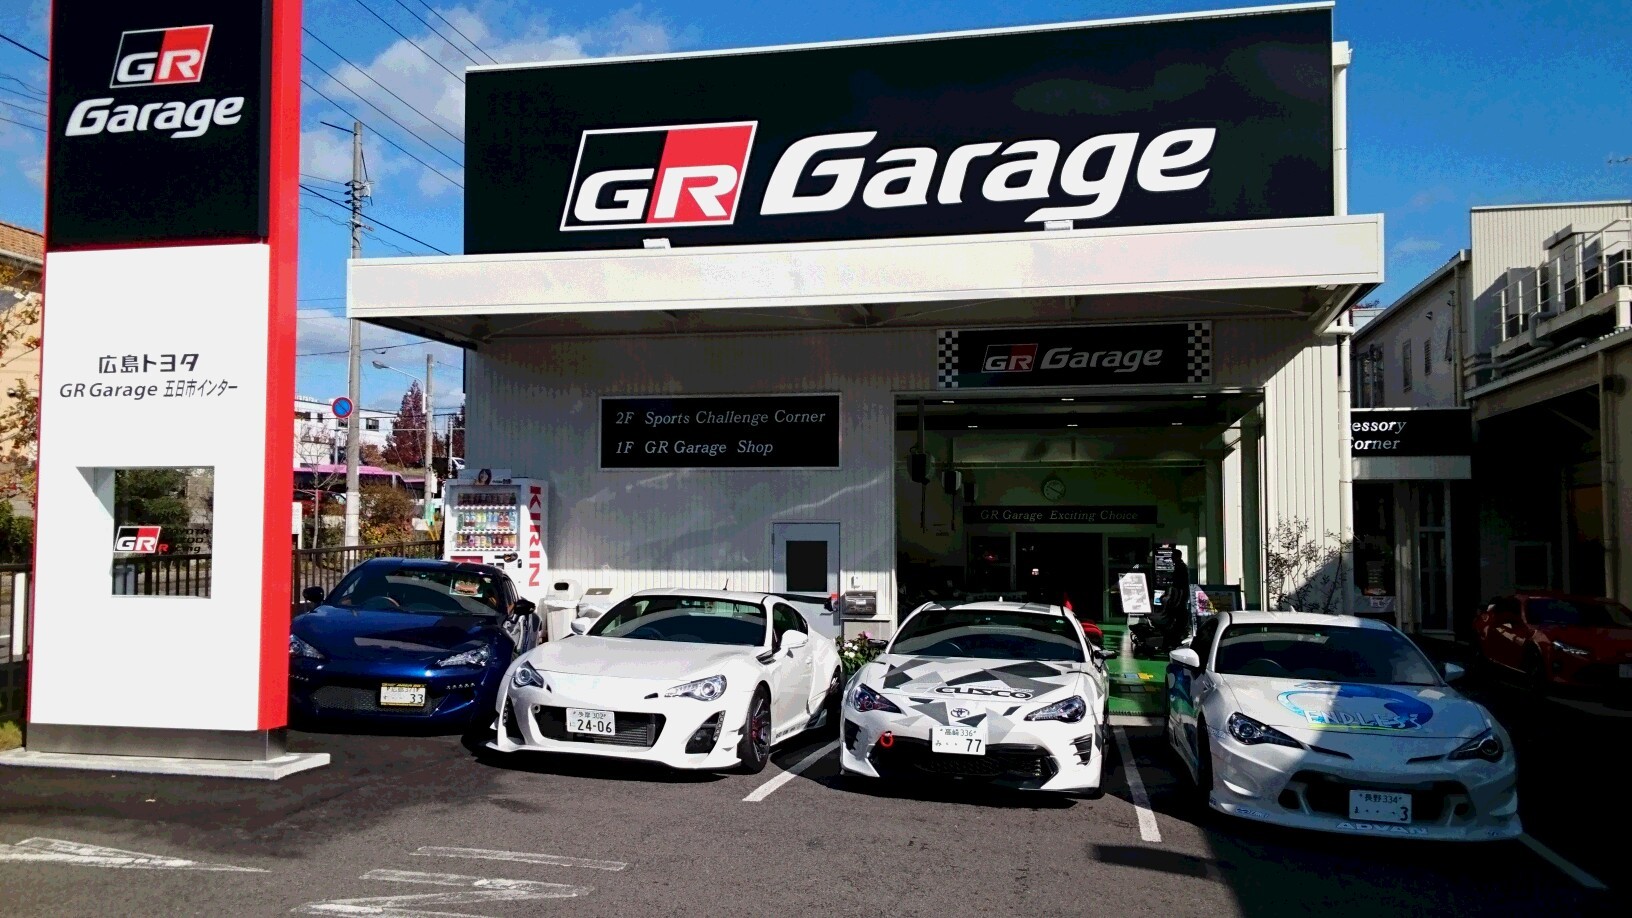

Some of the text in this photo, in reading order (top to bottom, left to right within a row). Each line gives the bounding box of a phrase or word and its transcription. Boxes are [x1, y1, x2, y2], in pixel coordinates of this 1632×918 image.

[117, 49, 201, 82] GR
[65, 97, 245, 138] Garage
[573, 127, 1217, 223] GR Garage
[99, 354, 199, 374] 広島トヨタ
[985, 347, 1164, 373] GR Garage
[59, 378, 238, 400] GR Garage 五日市インター
[616, 409, 826, 427] 2F Sports Challenge Corner
[1351, 421, 1407, 434] essory
[615, 440, 774, 456] 1F GR Garage Shop
[980, 509, 1138, 522] GR Garage Exciting Choice
[116, 536, 157, 551] GR
[528, 486, 541, 587] KIRIN
[410, 694, 424, 703] 33
[577, 719, 613, 733] 24-06
[1303, 709, 1423, 730] ENDLESS
[966, 739, 982, 752] 77
[1400, 806, 1409, 821] 3
[1336, 822, 1428, 834] ADVAN
